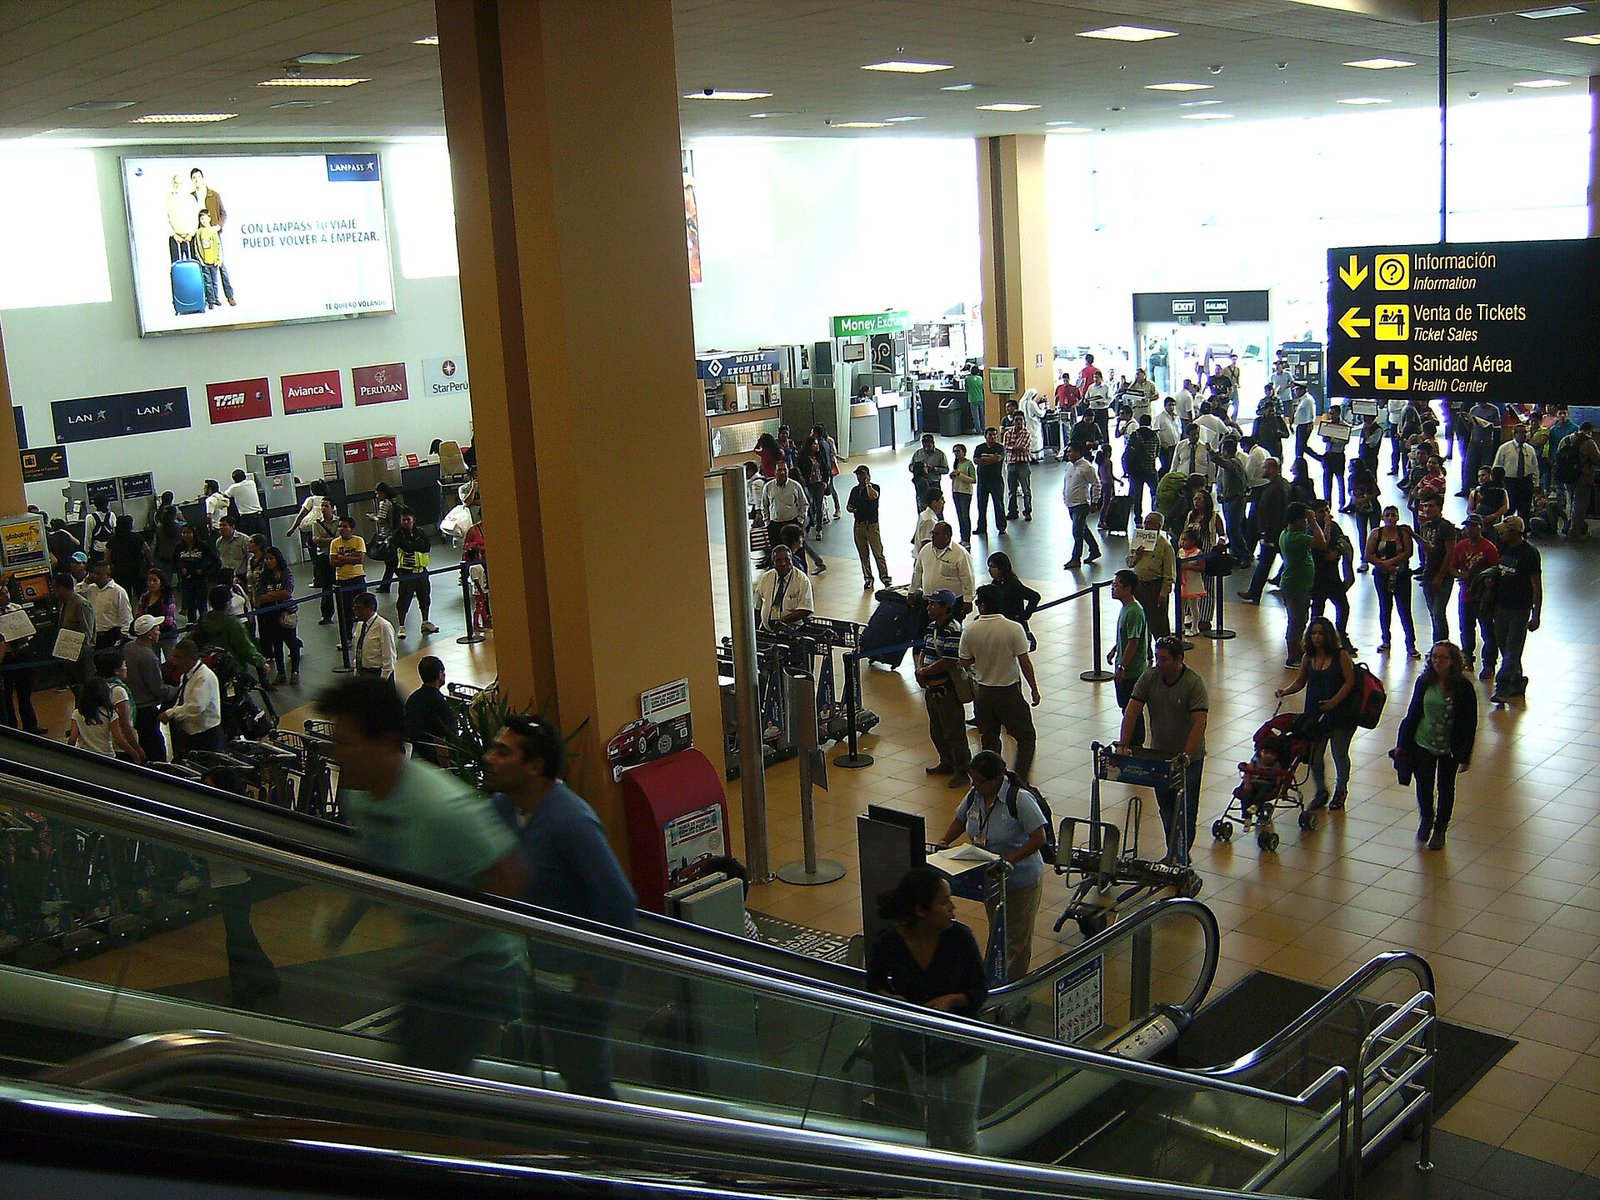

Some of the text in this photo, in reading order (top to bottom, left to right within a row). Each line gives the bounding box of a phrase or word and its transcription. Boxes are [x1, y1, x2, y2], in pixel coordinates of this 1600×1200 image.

[329, 163, 365, 172] LANPASS
[241, 223, 263, 235] CON
[266, 221, 312, 233] LANPASS
[330, 219, 357, 230] VIAJE
[242, 231, 380, 248] PUEDE VOLVER A EMPEZAR.
[1414, 251, 1497, 270] Información
[1413, 276, 1477, 290] Information
[1174, 302, 1195, 311] EXIT
[1413, 303, 1526, 321] Venta de Tickets
[841, 318, 876, 332] Money
[1413, 327, 1479, 341] Ticket Sales
[736, 353, 766, 364] MONEY
[1413, 354, 1513, 373] Sanidad Aérea
[727, 363, 773, 376] EXCHANGE
[287, 385, 325, 398] Avianca
[360, 383, 403, 396] PERUVIAN
[1412, 378, 1488, 393] Health Center
[213, 392, 245, 407] TAM
[136, 405, 161, 416] LAN
[68, 413, 93, 424] LAN
